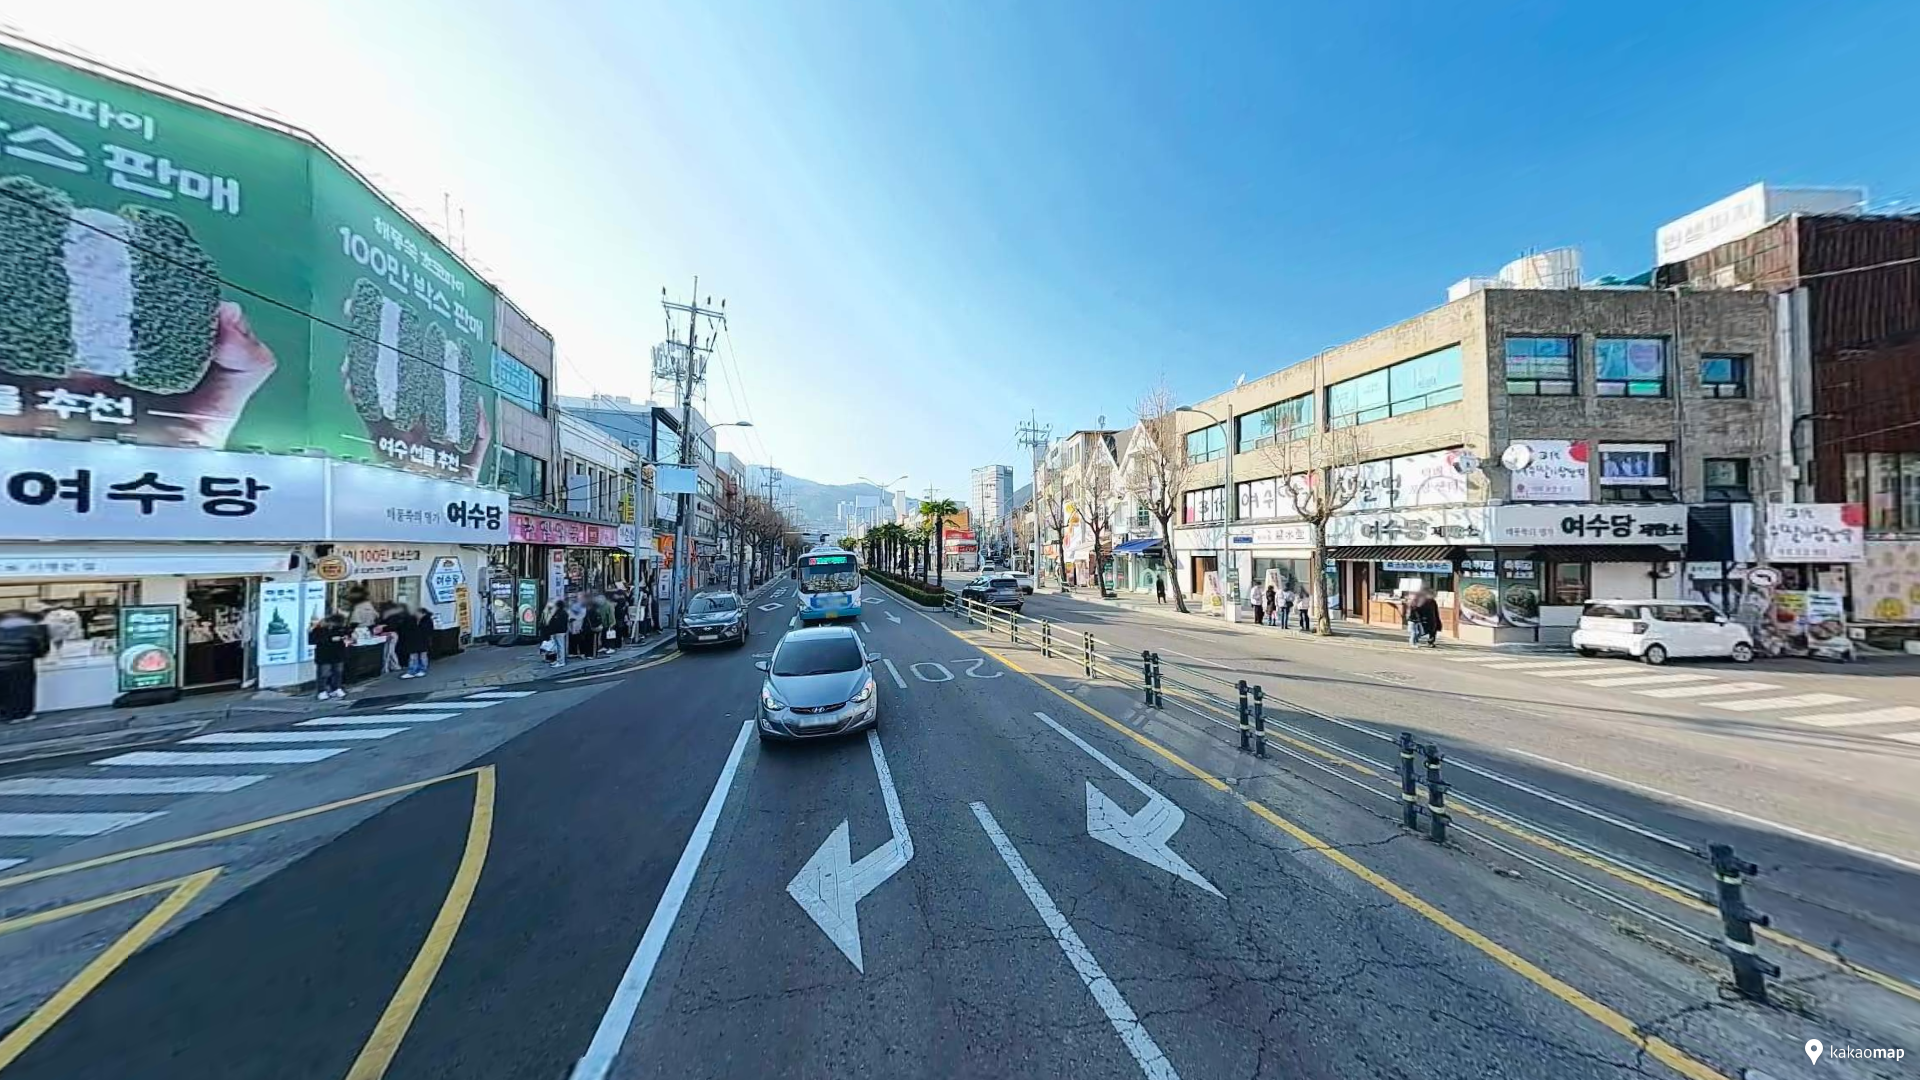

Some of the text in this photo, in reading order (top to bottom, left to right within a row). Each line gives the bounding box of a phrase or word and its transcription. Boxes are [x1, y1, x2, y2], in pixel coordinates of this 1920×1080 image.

[0, 74, 154, 141] 코파이
[102, 144, 240, 215] 판매
[339, 226, 484, 343] 100만 박스 판매
[420, 251, 466, 298] 초코파이
[35, 388, 136, 424] 추천
[378, 437, 461, 473] 여수 선물 추천
[7, 469, 272, 518] 여수당
[447, 500, 503, 531] 여수당
[1361, 520, 1430, 541] 여수당
[1561, 514, 1636, 538] 여수당
